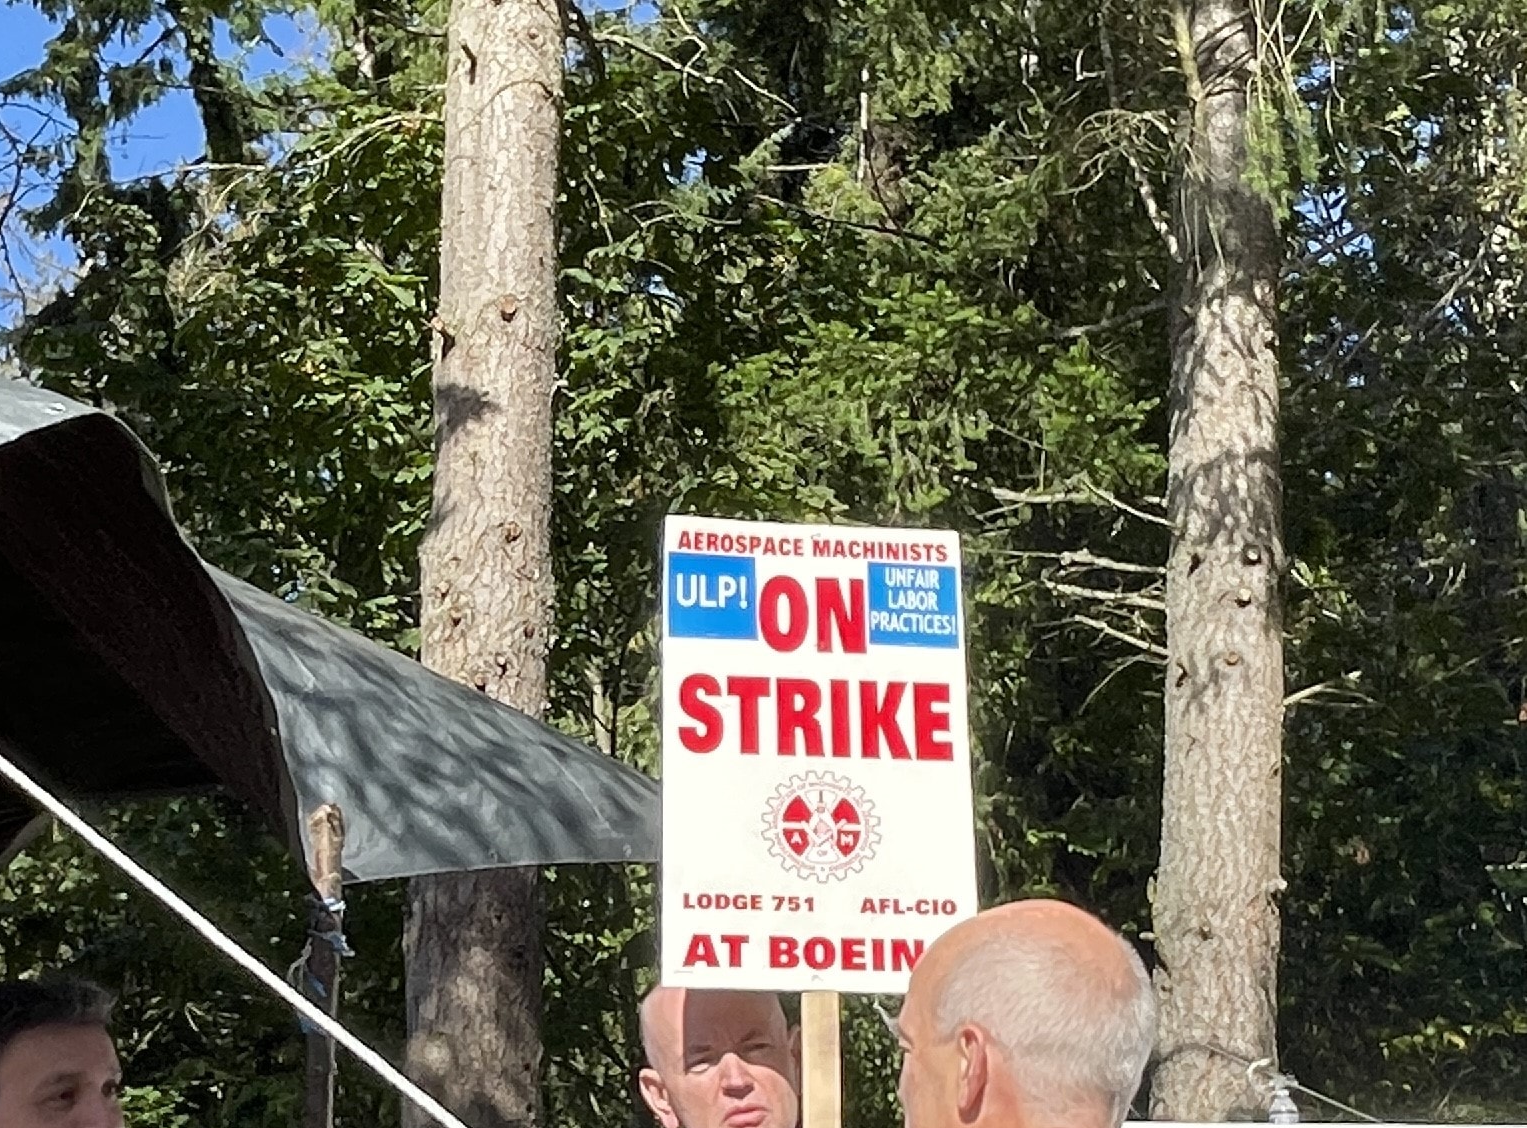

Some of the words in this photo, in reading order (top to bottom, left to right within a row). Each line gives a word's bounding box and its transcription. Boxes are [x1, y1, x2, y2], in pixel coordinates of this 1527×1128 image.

[678, 530, 804, 557] AEROSPACE
[813, 538, 948, 563] MACHINISTS
[677, 574, 747, 610] ULP!
[884, 566, 940, 589] UNFAIR
[759, 574, 867, 654] ON
[888, 590, 939, 611] LABOR
[870, 612, 957, 636] PRACTICES!
[677, 673, 954, 761] STRIKE
[683, 893, 763, 911] LODGE
[772, 896, 815, 912] 751
[860, 897, 957, 916] AFL-CIO
[682, 934, 750, 968] AT
[769, 935, 924, 972] BOEIN
